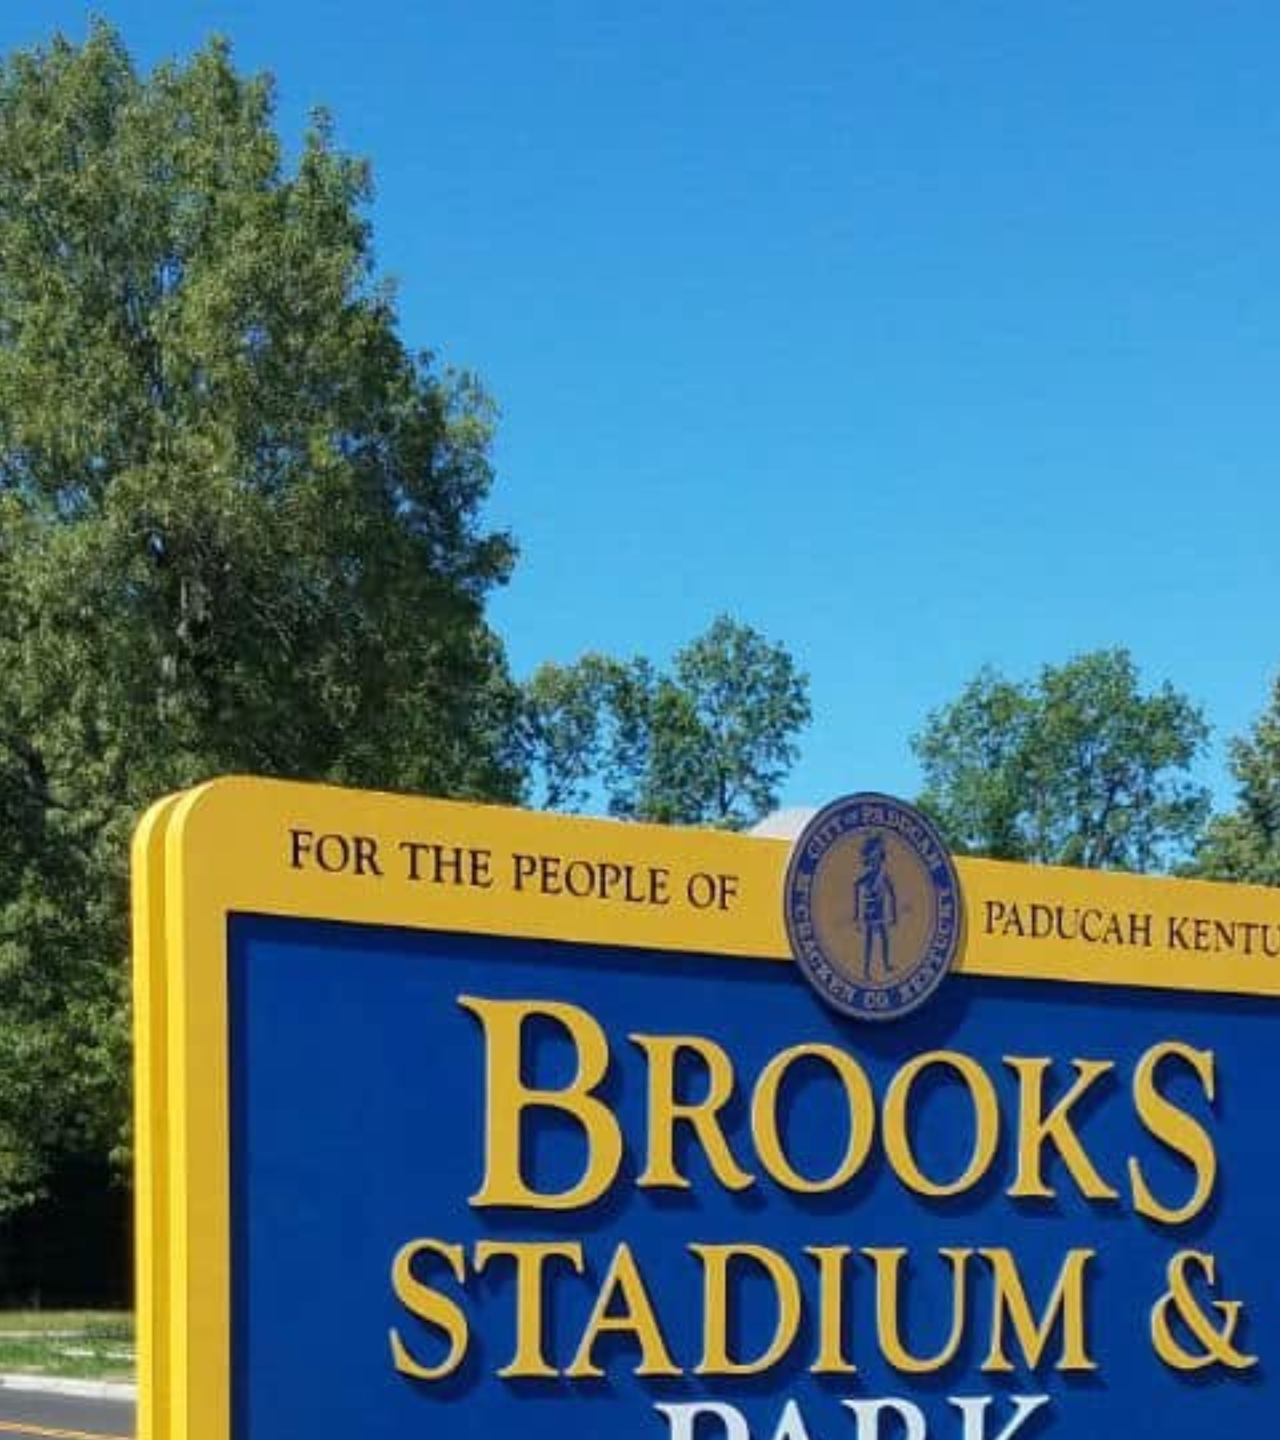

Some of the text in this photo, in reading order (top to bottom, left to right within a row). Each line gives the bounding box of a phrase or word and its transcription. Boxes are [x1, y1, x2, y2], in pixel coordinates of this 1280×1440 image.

[289, 829, 740, 910] FOR THE PEOPLE OF
[984, 900, 1152, 947] PADUCAH
[458, 994, 1217, 1225] BROOKS
[388, 1238, 1258, 1380] STADIUM &
